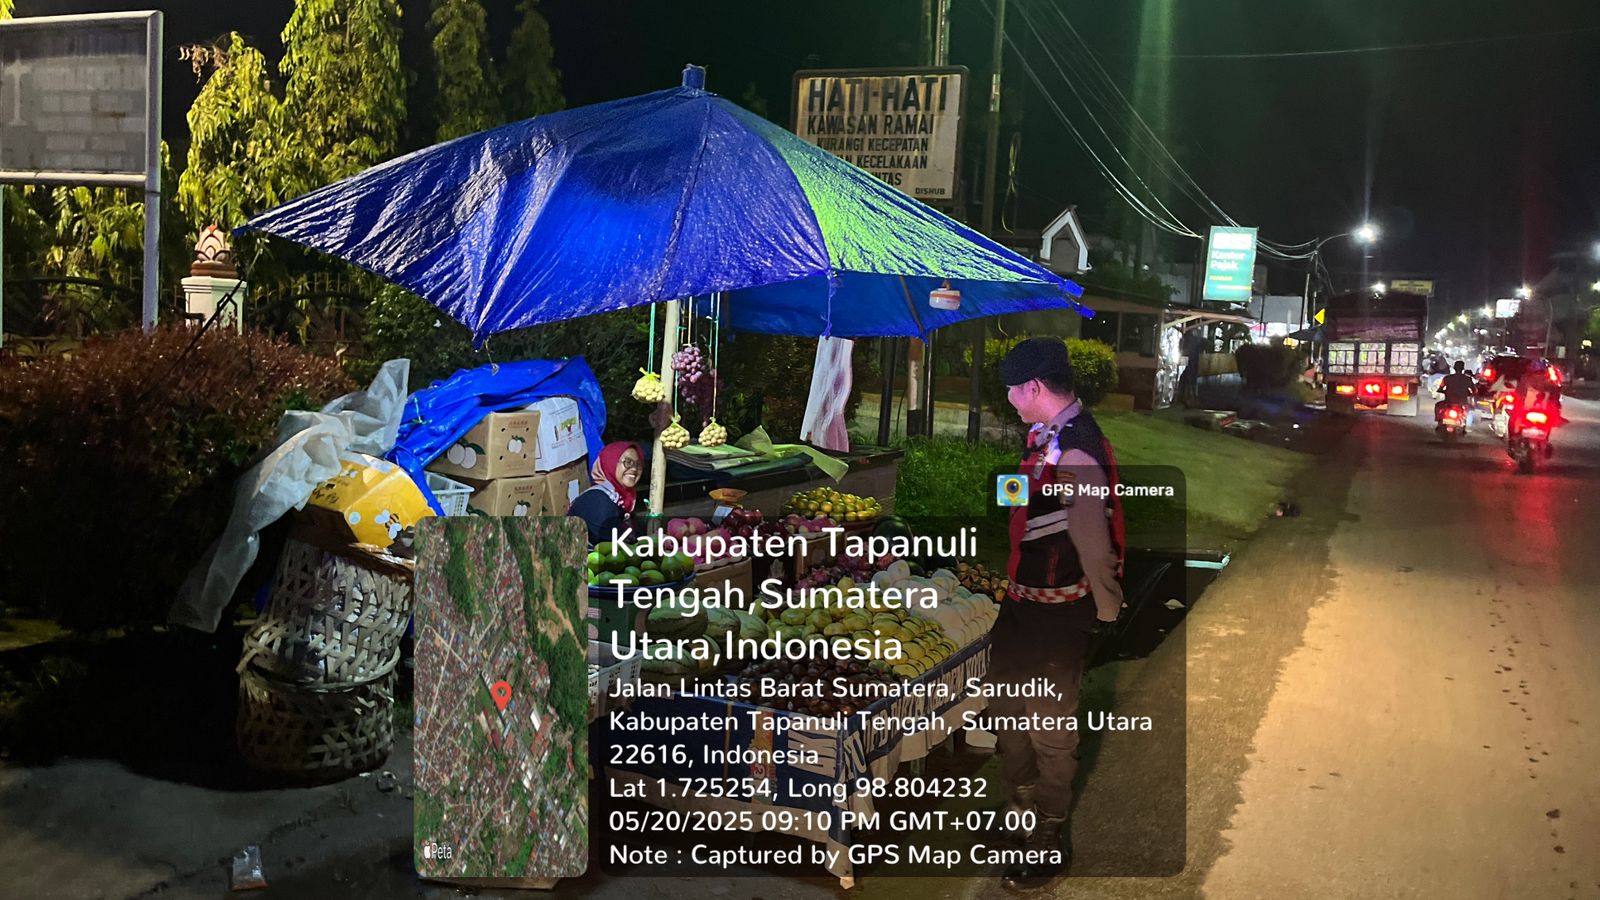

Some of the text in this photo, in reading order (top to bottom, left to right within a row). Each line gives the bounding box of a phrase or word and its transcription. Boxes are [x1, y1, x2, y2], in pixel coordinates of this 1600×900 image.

[807, 77, 948, 113] HATI-HATI
[807, 114, 935, 135] KAWASAN RAMAI
[816, 137, 929, 152] KURANGI KECEPATAN
[856, 154, 928, 169] KECELAKAAN
[915, 187, 946, 195] DISHUB
